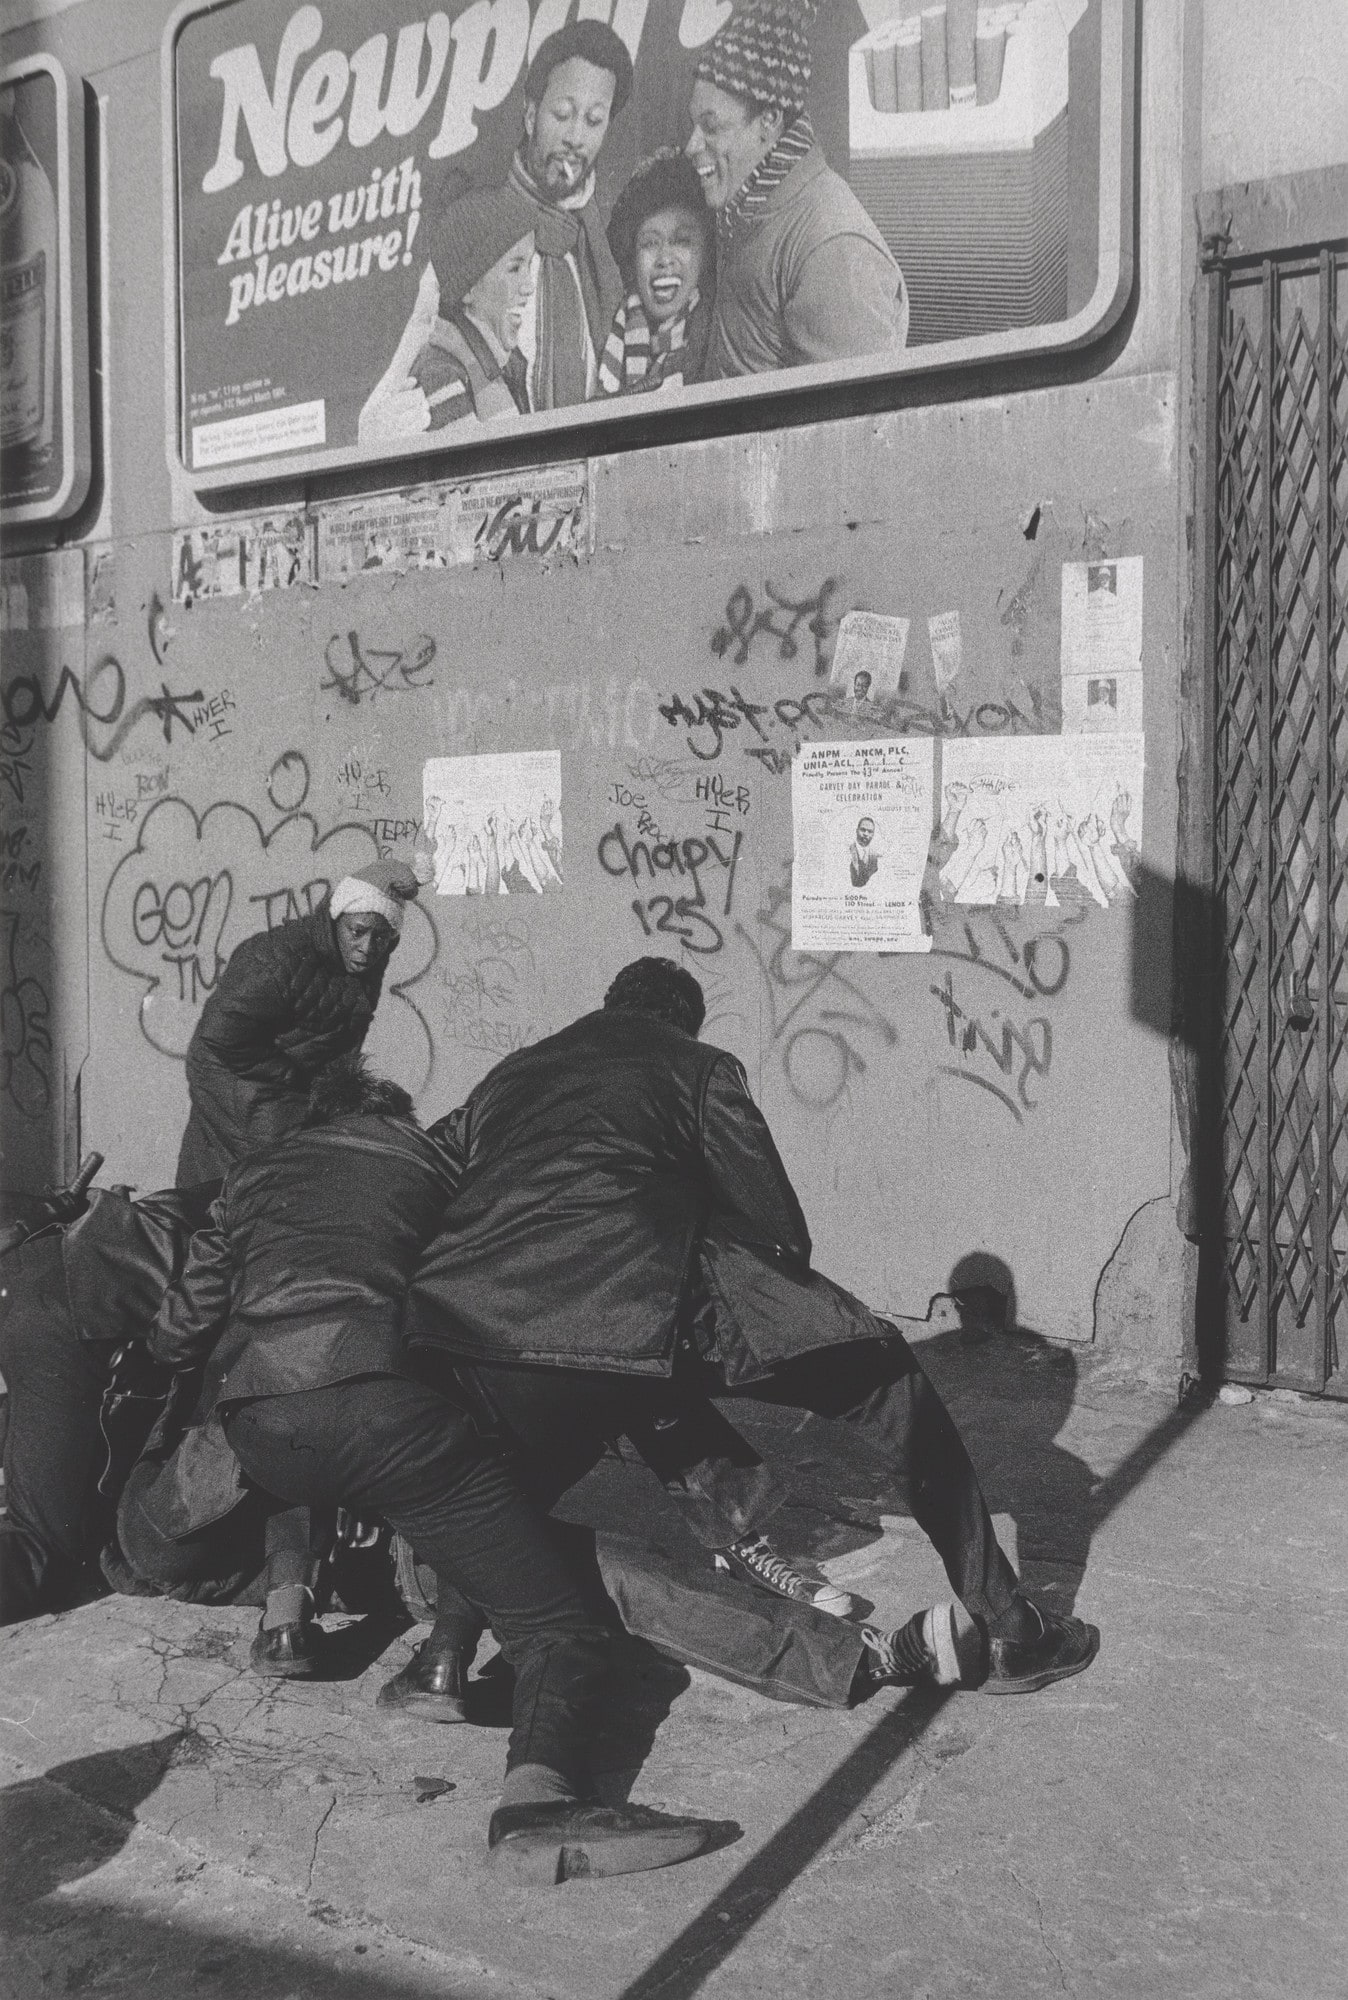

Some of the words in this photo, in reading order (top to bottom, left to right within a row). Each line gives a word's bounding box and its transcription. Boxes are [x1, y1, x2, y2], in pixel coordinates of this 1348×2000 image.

[217, 199, 323, 265] Alive
[328, 156, 422, 233] with
[225, 210, 420, 326] pleasure!
[192, 689, 236, 727] HYER
[811, 749, 840, 759] ANPM
[888, 746, 909, 755] PLC,
[819, 783, 844, 791] GARVEY
[848, 782, 861, 790] DAY
[866, 781, 891, 789] PARADE
[835, 793, 883, 802] CELEBRATION
[631, 895, 724, 954] 125
